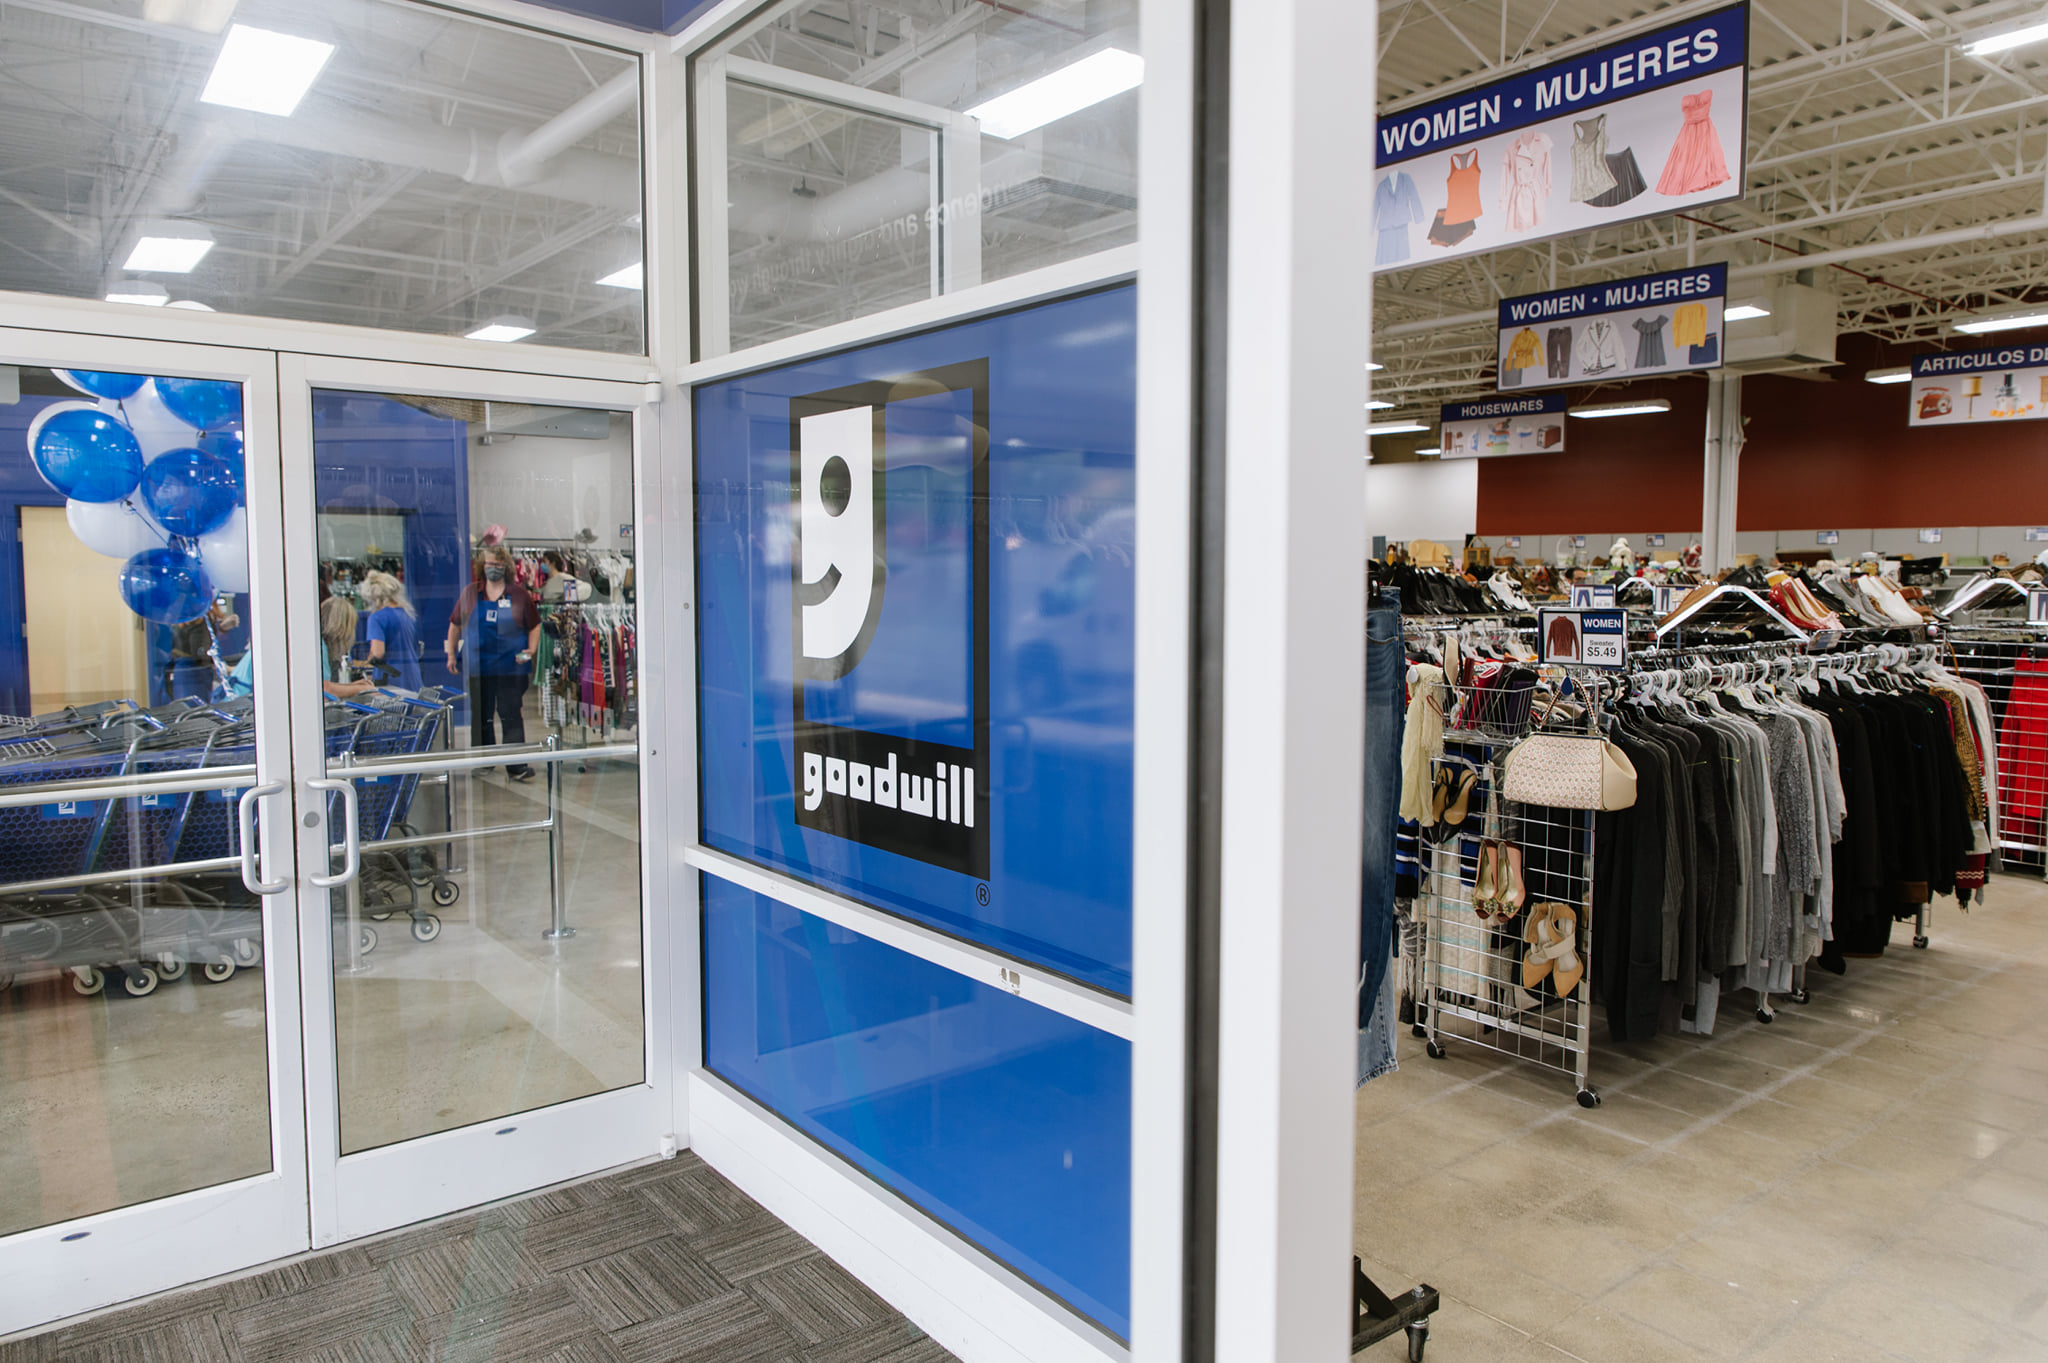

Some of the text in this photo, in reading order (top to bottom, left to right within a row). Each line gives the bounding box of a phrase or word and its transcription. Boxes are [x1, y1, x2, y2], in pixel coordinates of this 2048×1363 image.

[1381, 28, 1719, 155] WOMEN MUJERES
[1511, 274, 1711, 321] WOMEN MUJERES
[1919, 349, 2025, 372] ARTICULOS
[1461, 399, 1544, 417] HOUSEWARES
[1583, 618, 1622, 628] WOMEN
[1587, 646, 1617, 657] $5.49
[803, 751, 975, 828] goodwill
